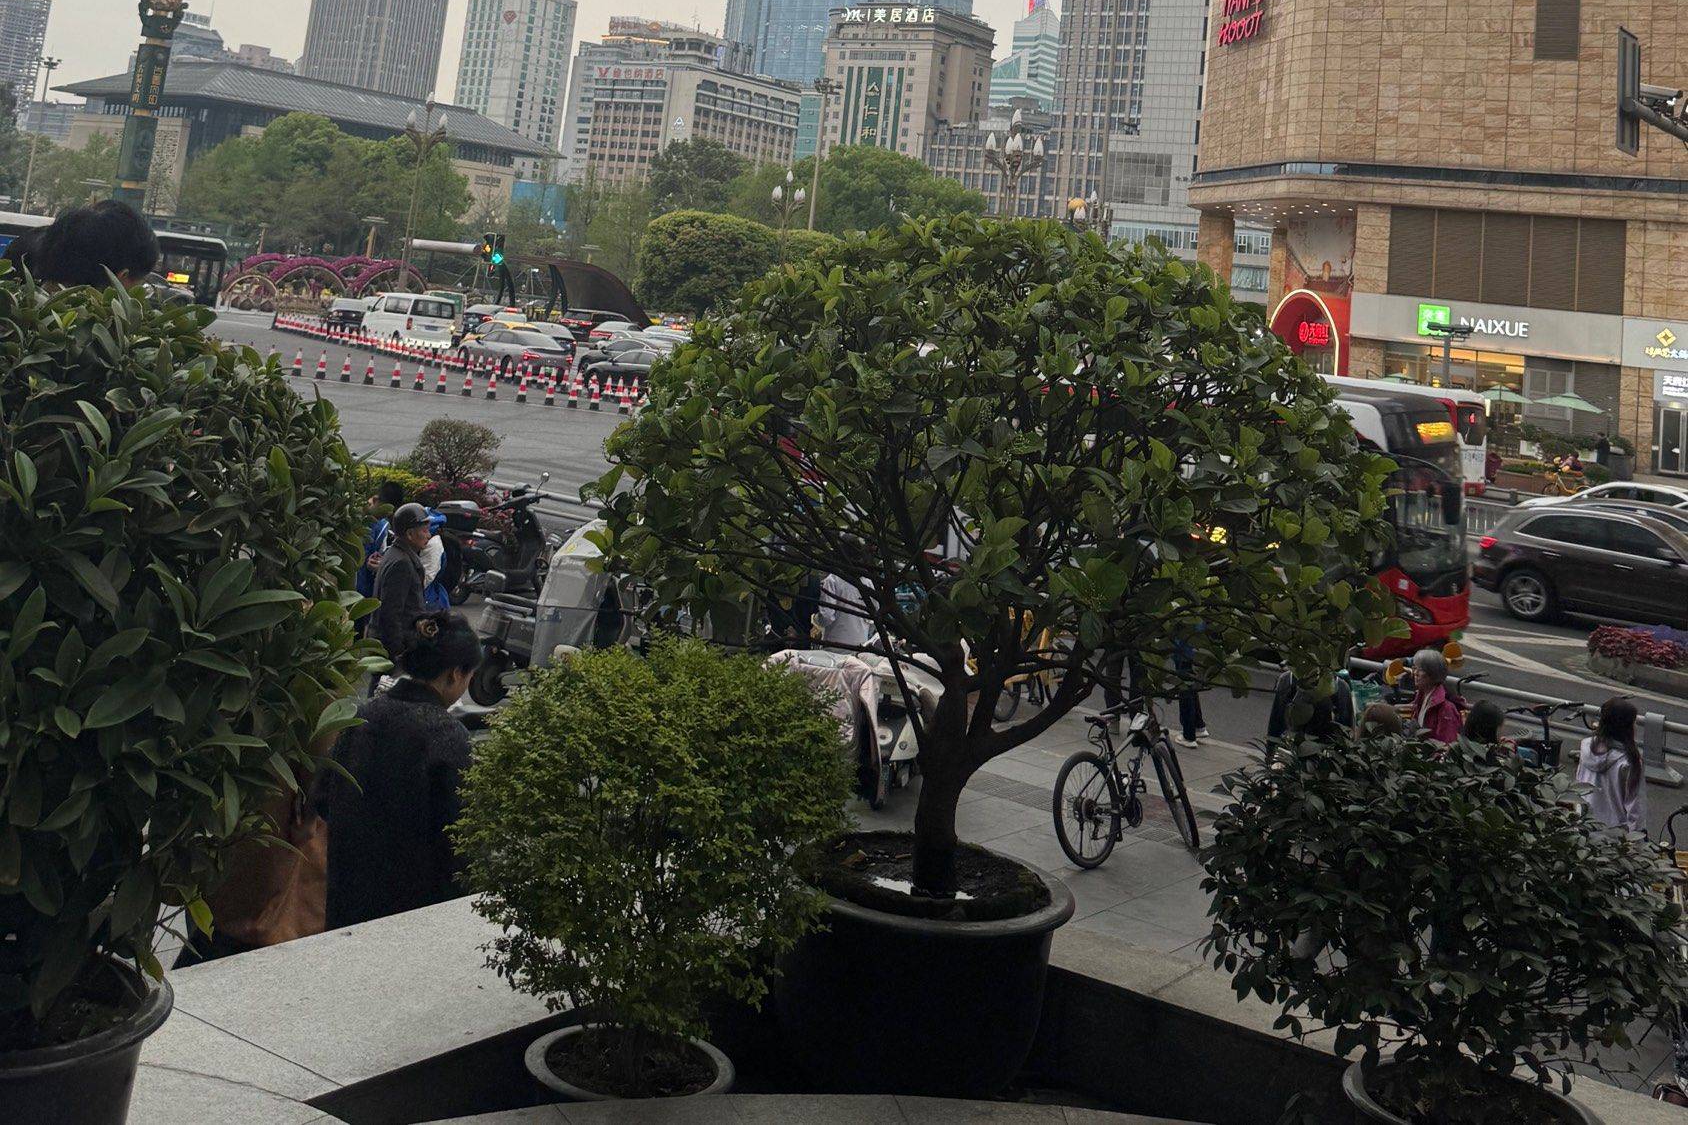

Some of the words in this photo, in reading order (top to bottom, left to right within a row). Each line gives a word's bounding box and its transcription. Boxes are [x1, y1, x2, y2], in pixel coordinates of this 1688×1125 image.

[873, 7, 935, 23] 美居酒店
[1460, 317, 1529, 338] NAIXUE
